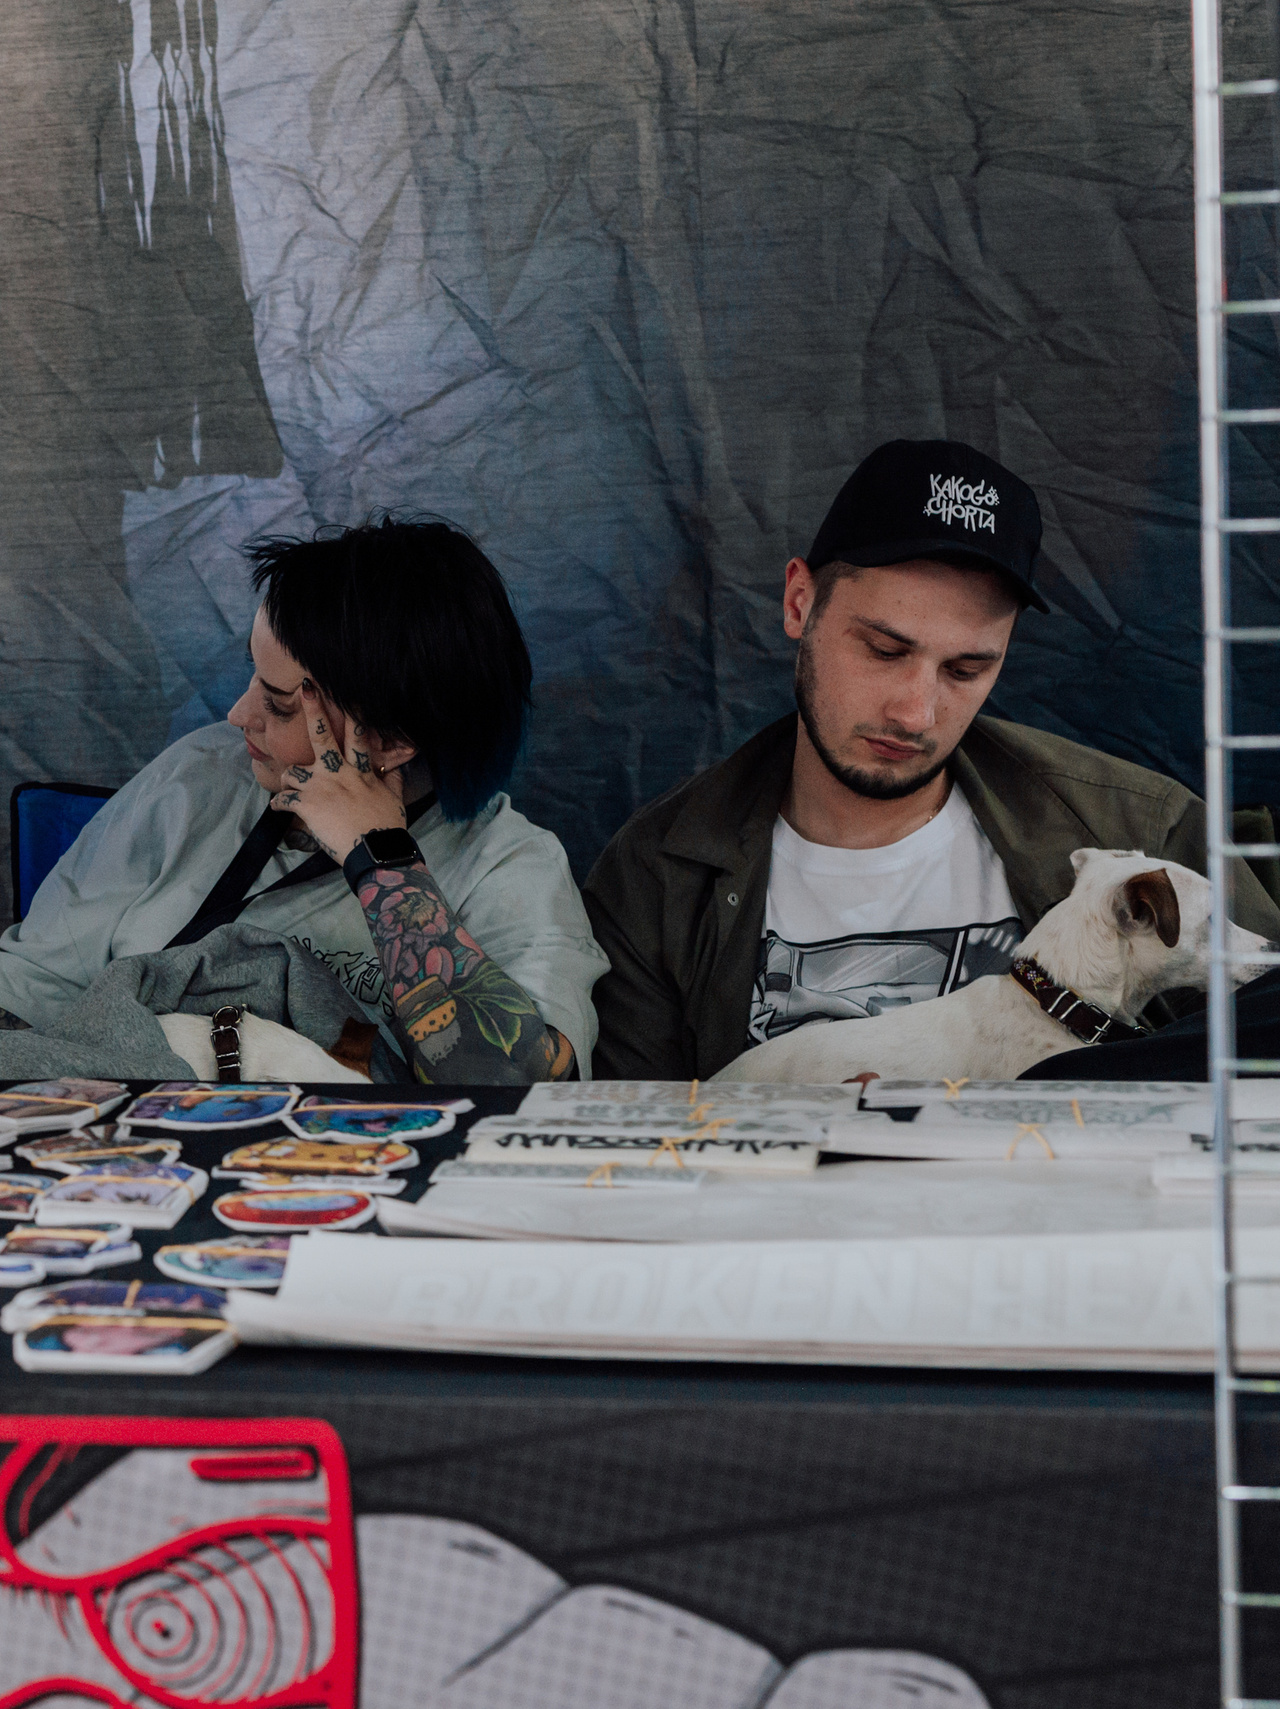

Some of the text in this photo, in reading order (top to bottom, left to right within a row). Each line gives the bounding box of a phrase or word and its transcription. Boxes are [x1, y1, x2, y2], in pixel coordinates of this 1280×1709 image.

[930, 474, 1000, 506] KAKOGO
[925, 495, 995, 534] CHORTA
[386, 1250, 915, 1330] BROKEN
